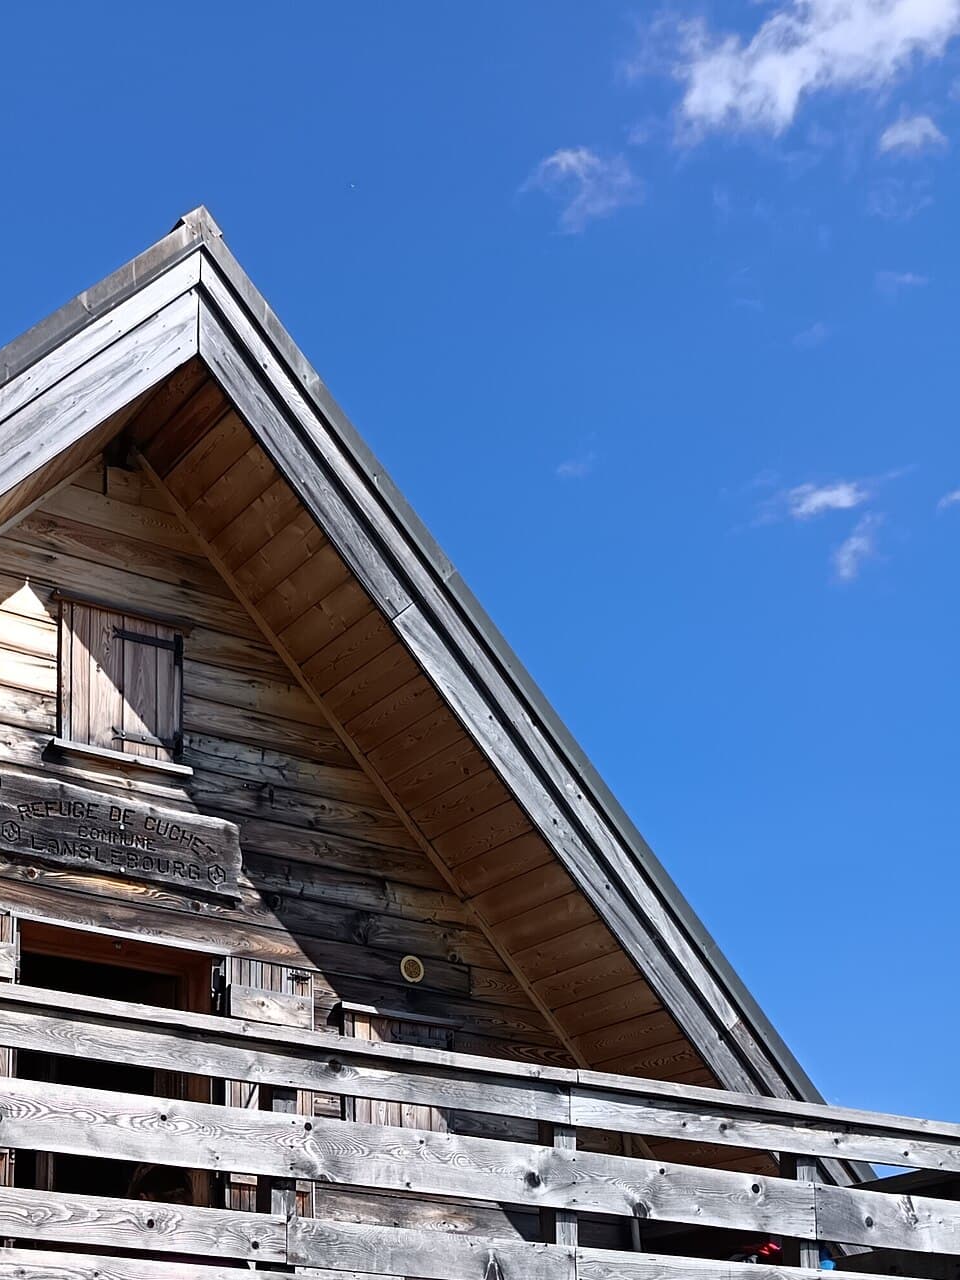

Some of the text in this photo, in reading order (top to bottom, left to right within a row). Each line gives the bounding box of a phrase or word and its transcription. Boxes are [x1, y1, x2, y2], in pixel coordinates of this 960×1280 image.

[17, 801, 219, 858] REFUGE DE CUCHET
[77, 825, 157, 852] COMMUNE
[30, 835, 201, 881] LANSLEBOURG
